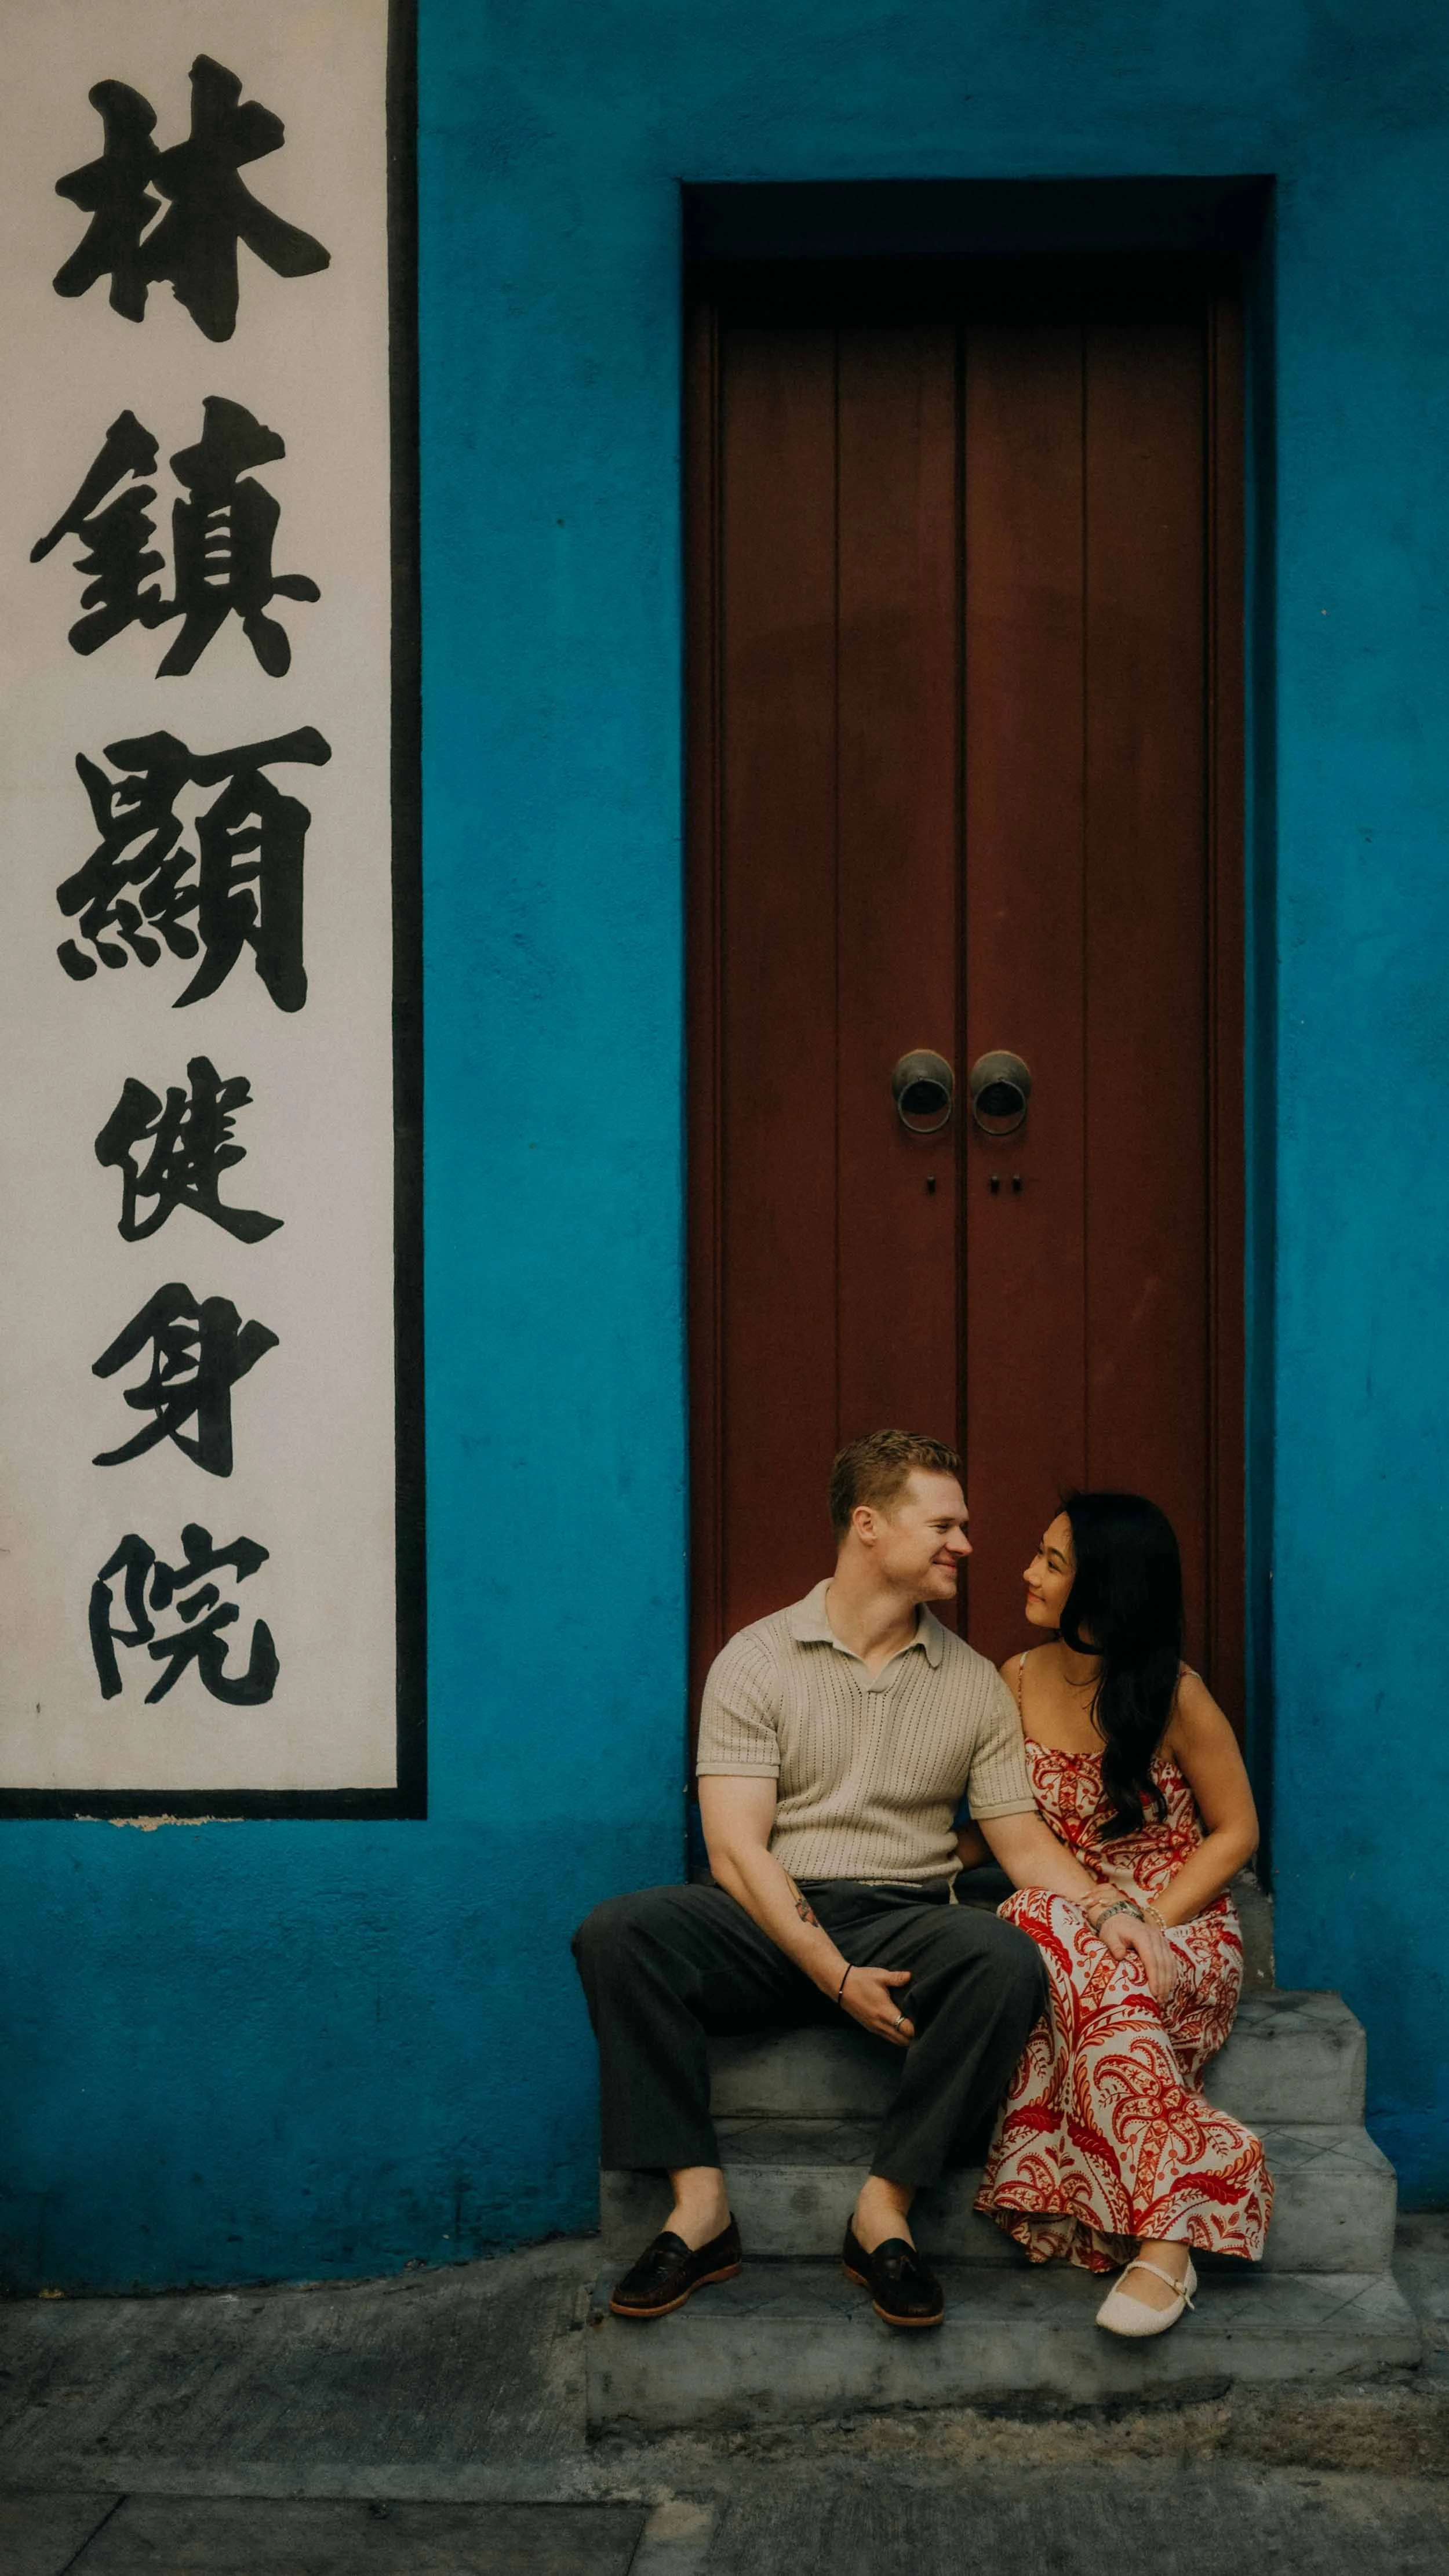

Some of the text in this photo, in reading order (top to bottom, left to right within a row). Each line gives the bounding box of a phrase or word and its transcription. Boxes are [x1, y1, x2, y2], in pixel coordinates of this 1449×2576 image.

[30, 53, 332, 1706] 林鎮顯健身院
